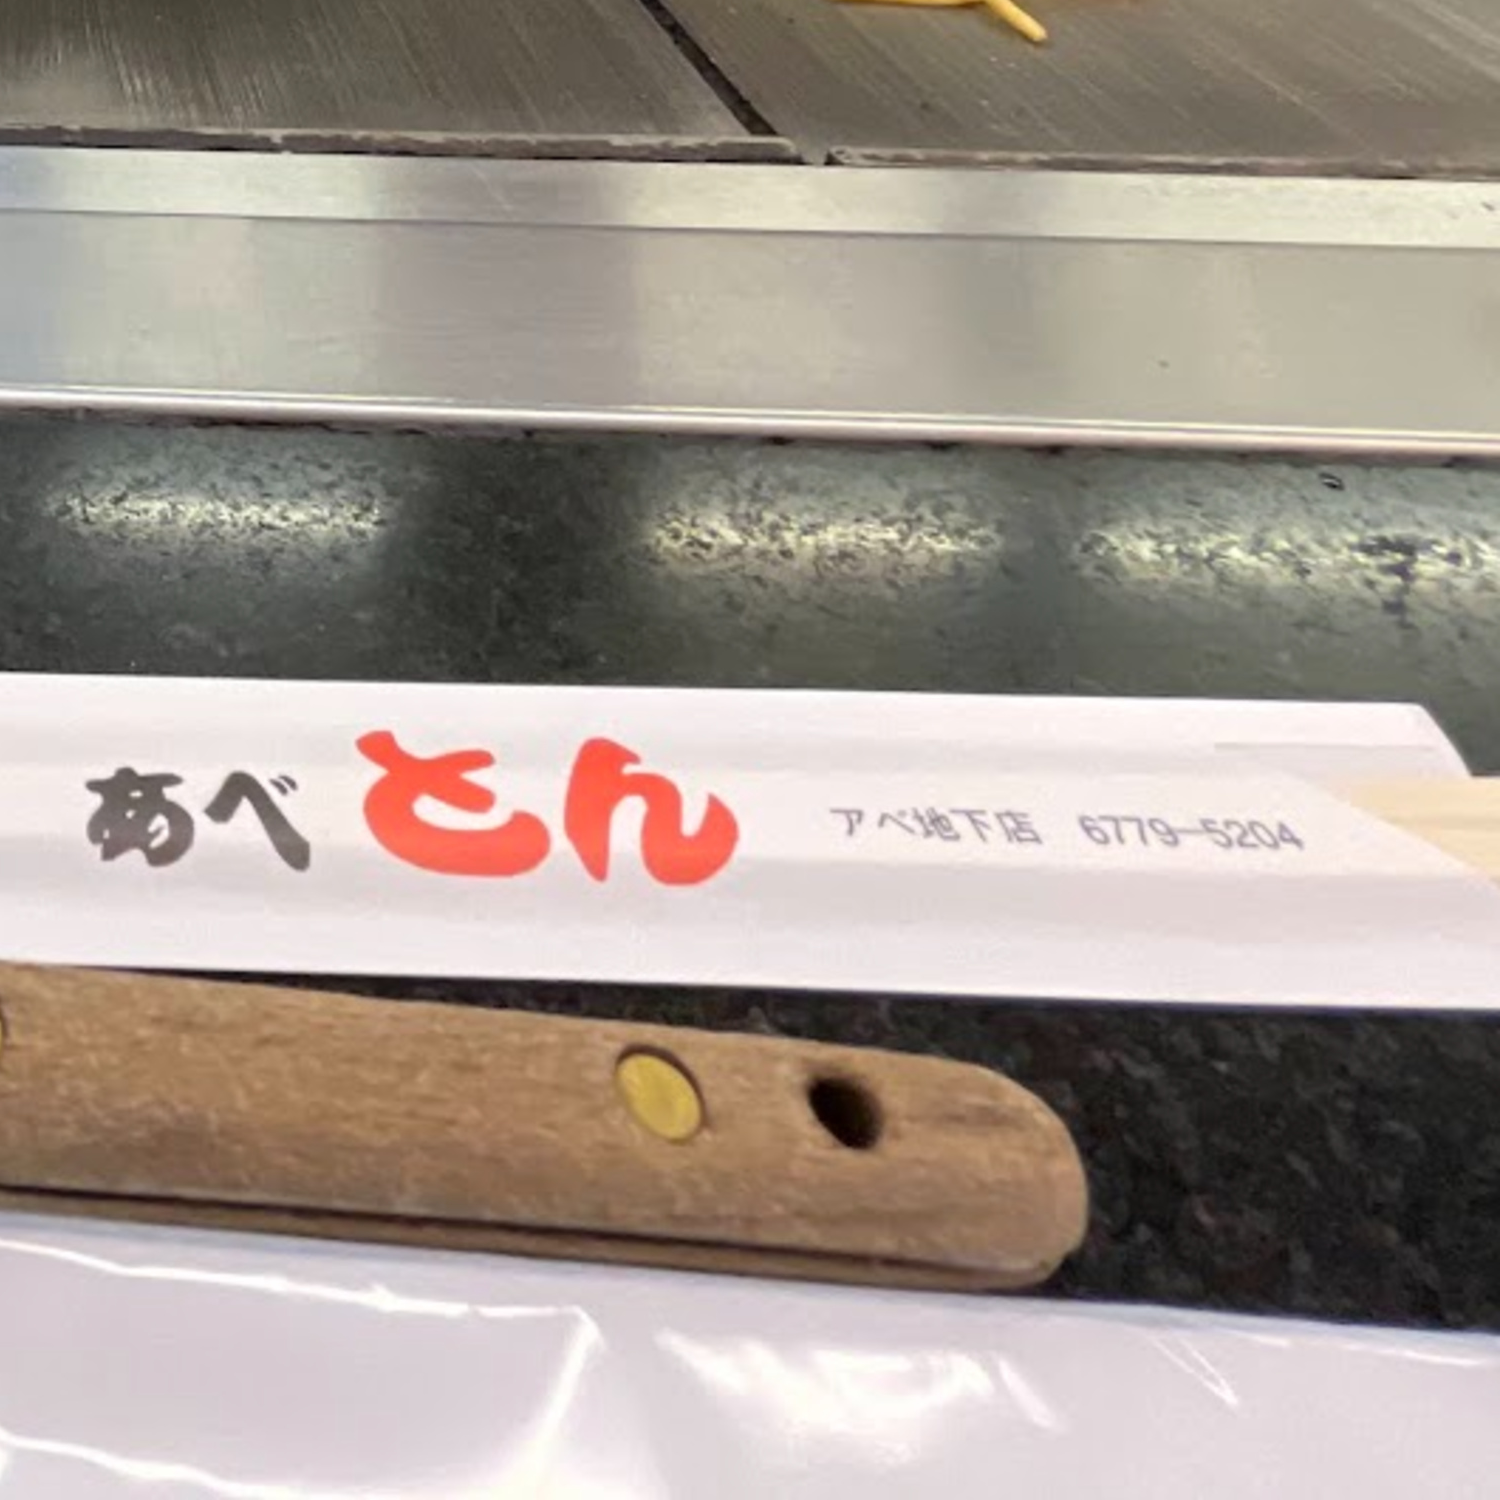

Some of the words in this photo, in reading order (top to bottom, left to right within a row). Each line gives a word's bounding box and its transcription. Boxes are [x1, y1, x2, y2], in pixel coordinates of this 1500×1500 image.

[829, 806, 1044, 846] アベ地下店
[1077, 814, 1305, 852] 6779-5204
